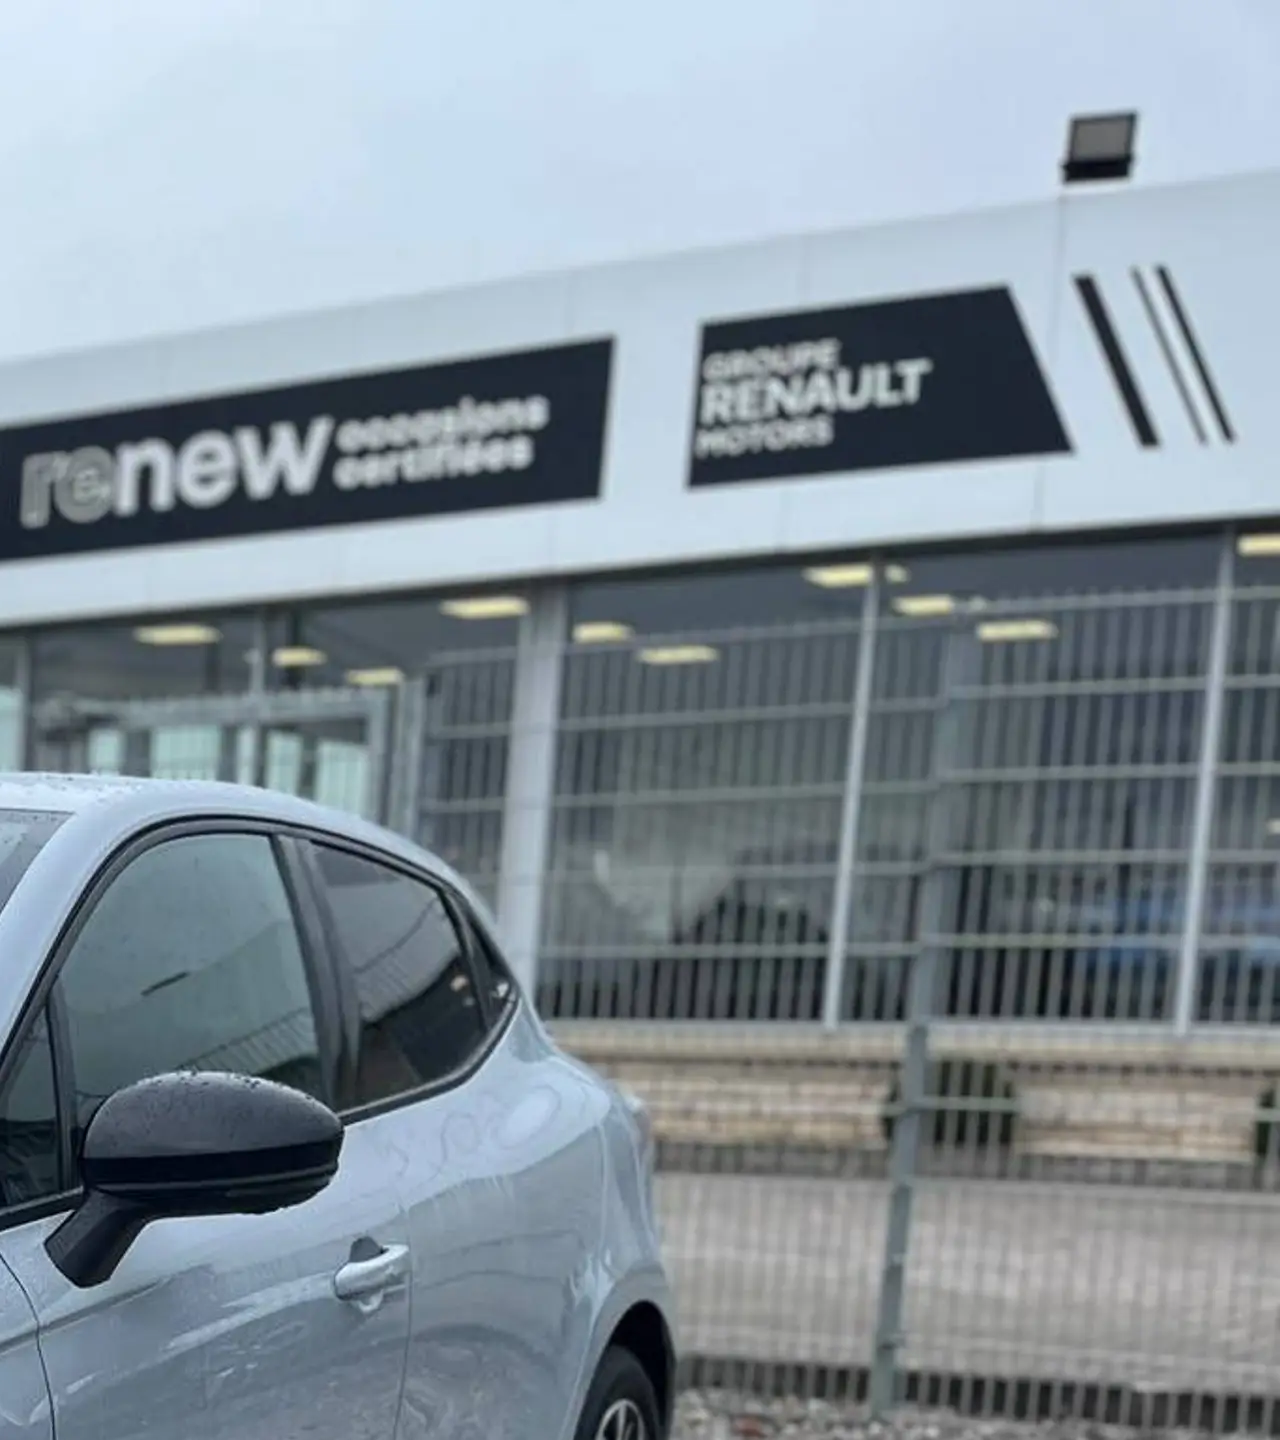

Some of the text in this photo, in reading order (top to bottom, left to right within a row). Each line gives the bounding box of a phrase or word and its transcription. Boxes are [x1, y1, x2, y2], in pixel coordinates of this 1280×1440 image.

[702, 337, 841, 383] GROUPE
[699, 356, 933, 427] RENAULT
[695, 414, 834, 459] MOTORS
[20, 415, 334, 529] renew
